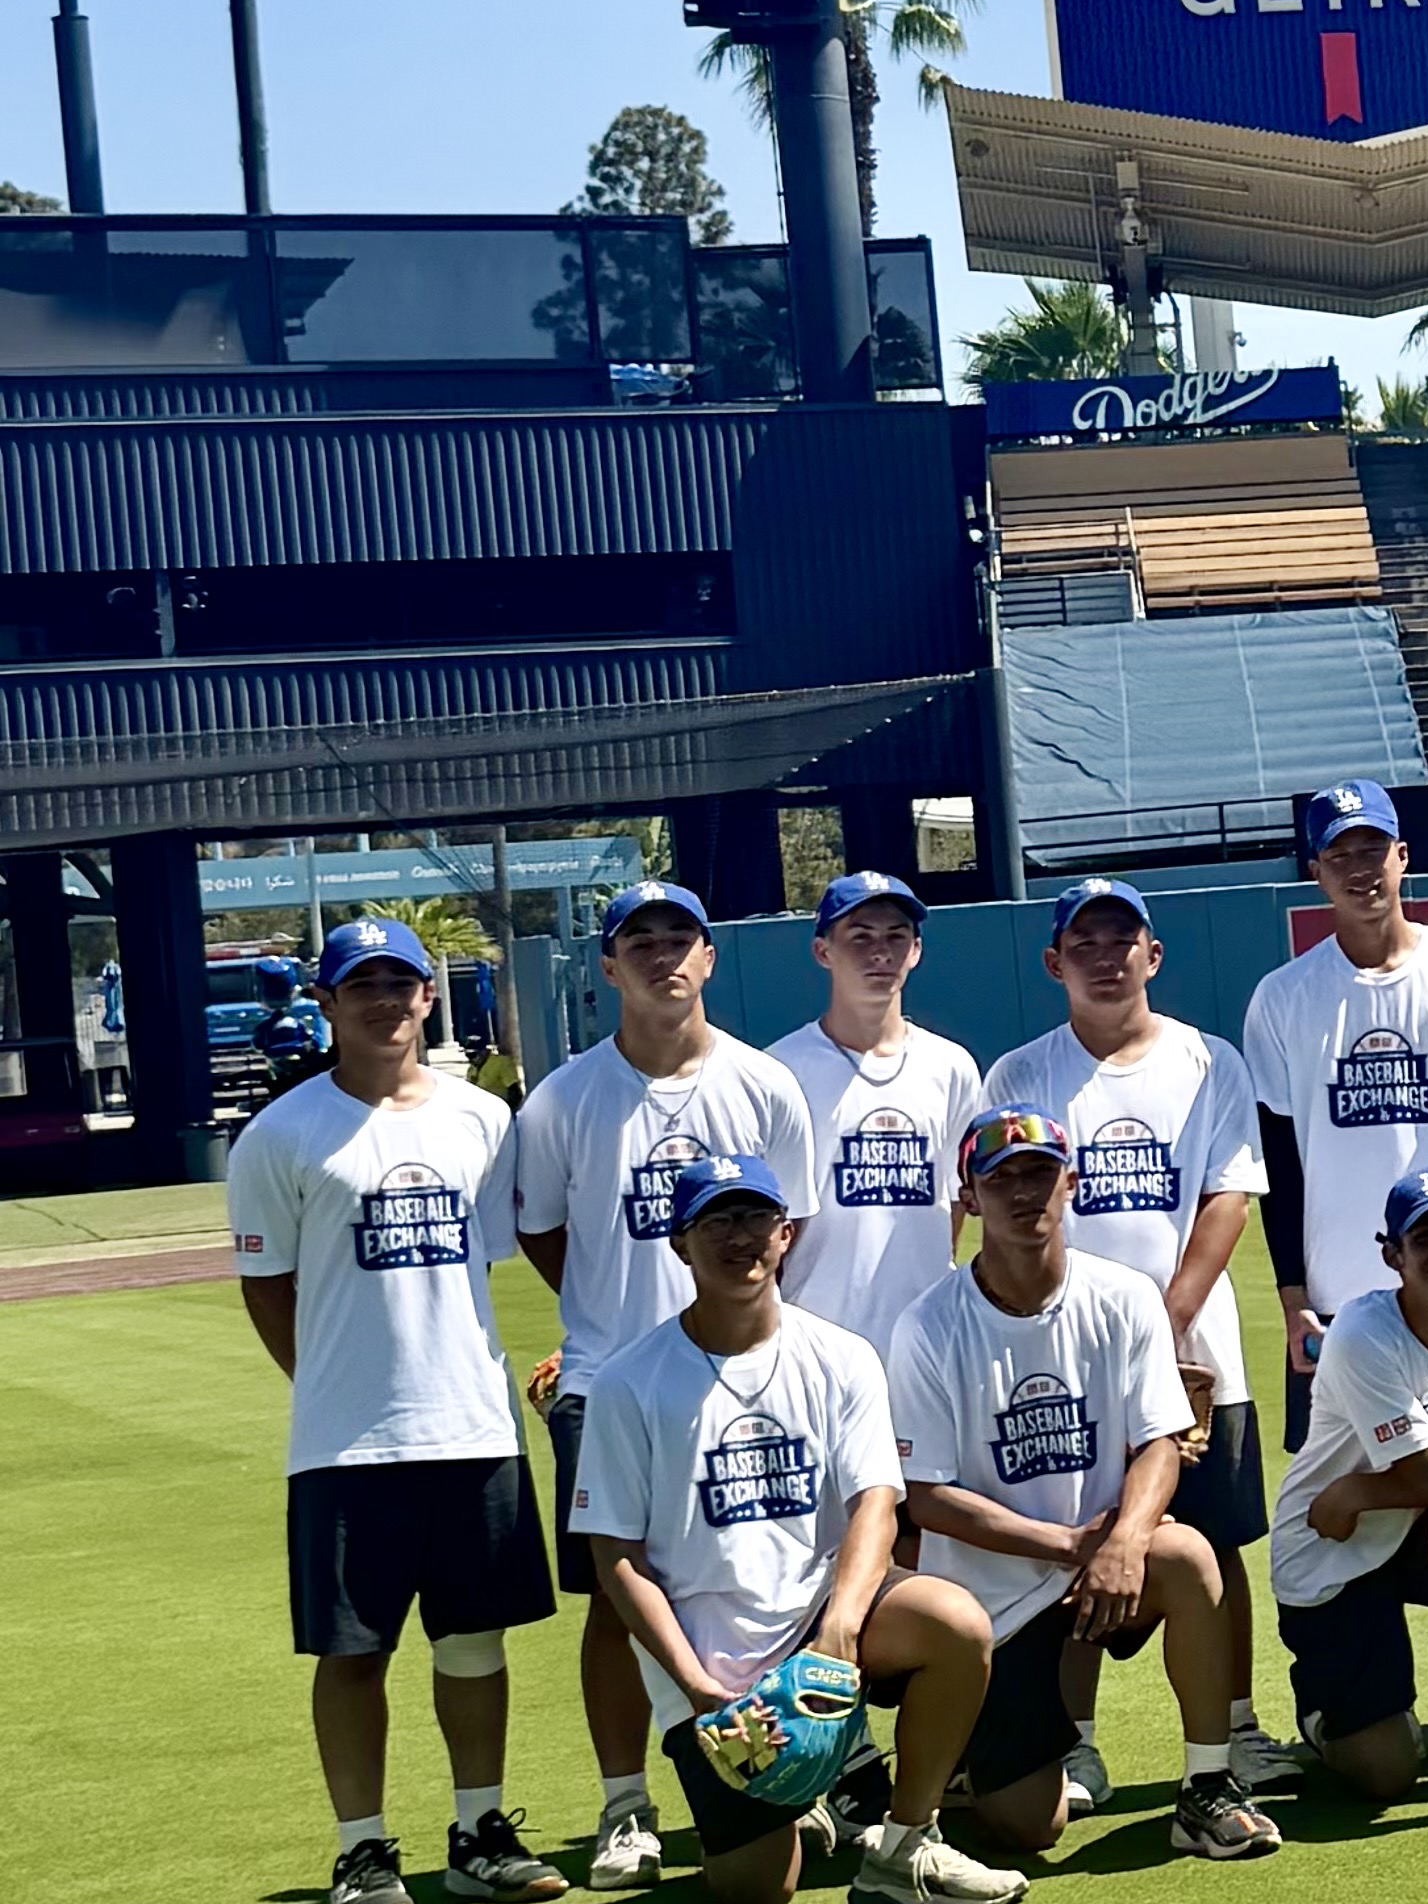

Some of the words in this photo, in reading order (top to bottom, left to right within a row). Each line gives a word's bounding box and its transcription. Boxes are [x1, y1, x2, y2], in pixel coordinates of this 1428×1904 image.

[1344, 1060, 1420, 1085] BASEBALL
[1337, 1086, 1428, 1120] EXCHANGE
[850, 1141, 924, 1165] BASEBALL
[1085, 1148, 1166, 1174] BASEBALL
[842, 1167, 932, 1196] EXCHANGE
[1079, 1174, 1173, 1206] EXCHANGE
[371, 1195, 455, 1224] BASEBALL
[364, 1223, 463, 1261] EXCHANGE
[1004, 1399, 1082, 1437] BASEBALL
[713, 1446, 800, 1476] BASEBALL
[1001, 1429, 1091, 1474] EXCHANGE
[709, 1471, 813, 1517] EXCHANGE
